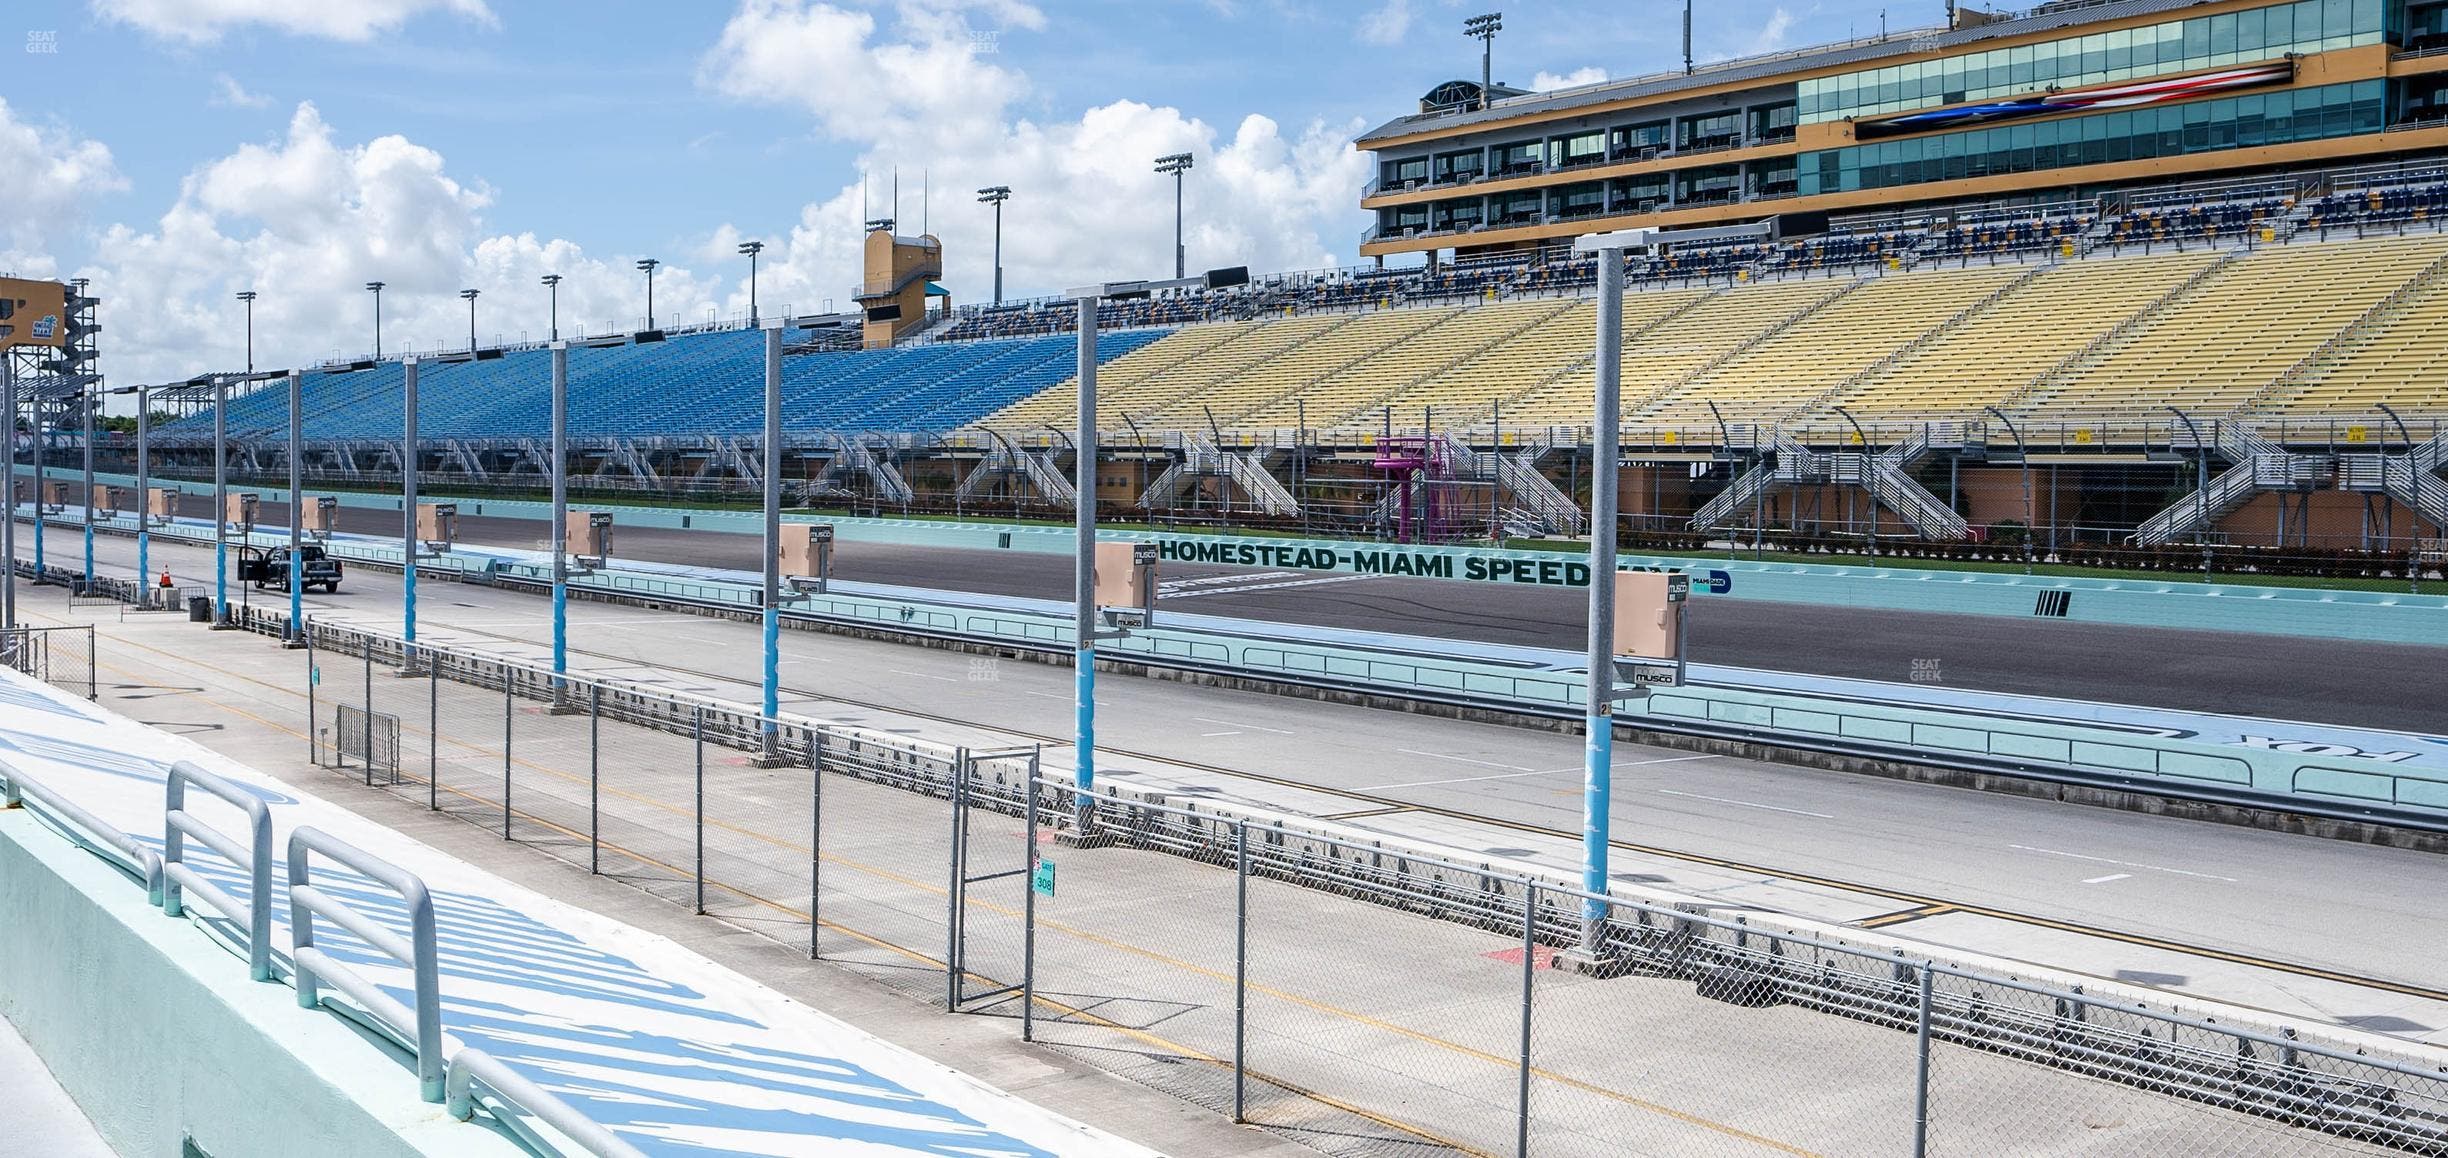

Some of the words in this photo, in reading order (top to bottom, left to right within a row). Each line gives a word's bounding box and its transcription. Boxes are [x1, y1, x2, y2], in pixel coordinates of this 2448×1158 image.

[1134, 551, 1157, 559] musco
[1159, 540, 1453, 577] HOMESTEAD-MIAMI
[1668, 584, 1687, 593] musco
[1636, 674, 1672, 683] musco
[1037, 876, 1051, 891] 308
